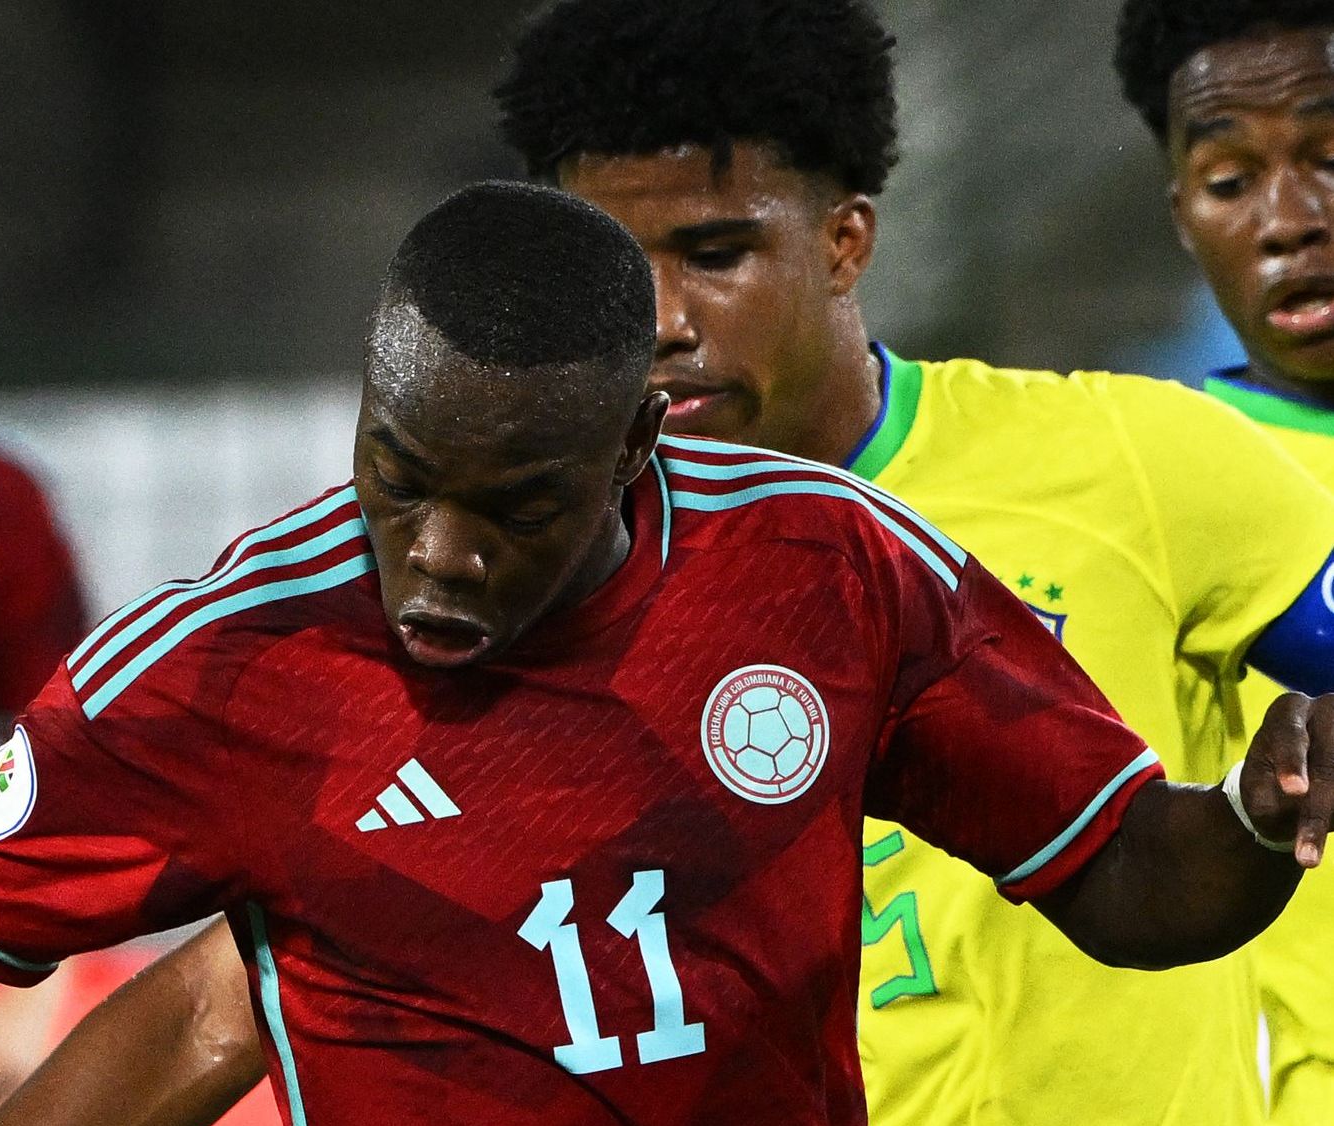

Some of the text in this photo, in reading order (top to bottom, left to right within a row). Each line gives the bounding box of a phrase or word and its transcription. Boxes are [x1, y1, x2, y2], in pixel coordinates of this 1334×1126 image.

[731, 673, 785, 694] COLOMBIANA
[786, 680, 799, 692] DE
[797, 688, 820, 722] FUTBOL
[517, 869, 706, 1075] 11
[862, 830, 938, 1010] 5
